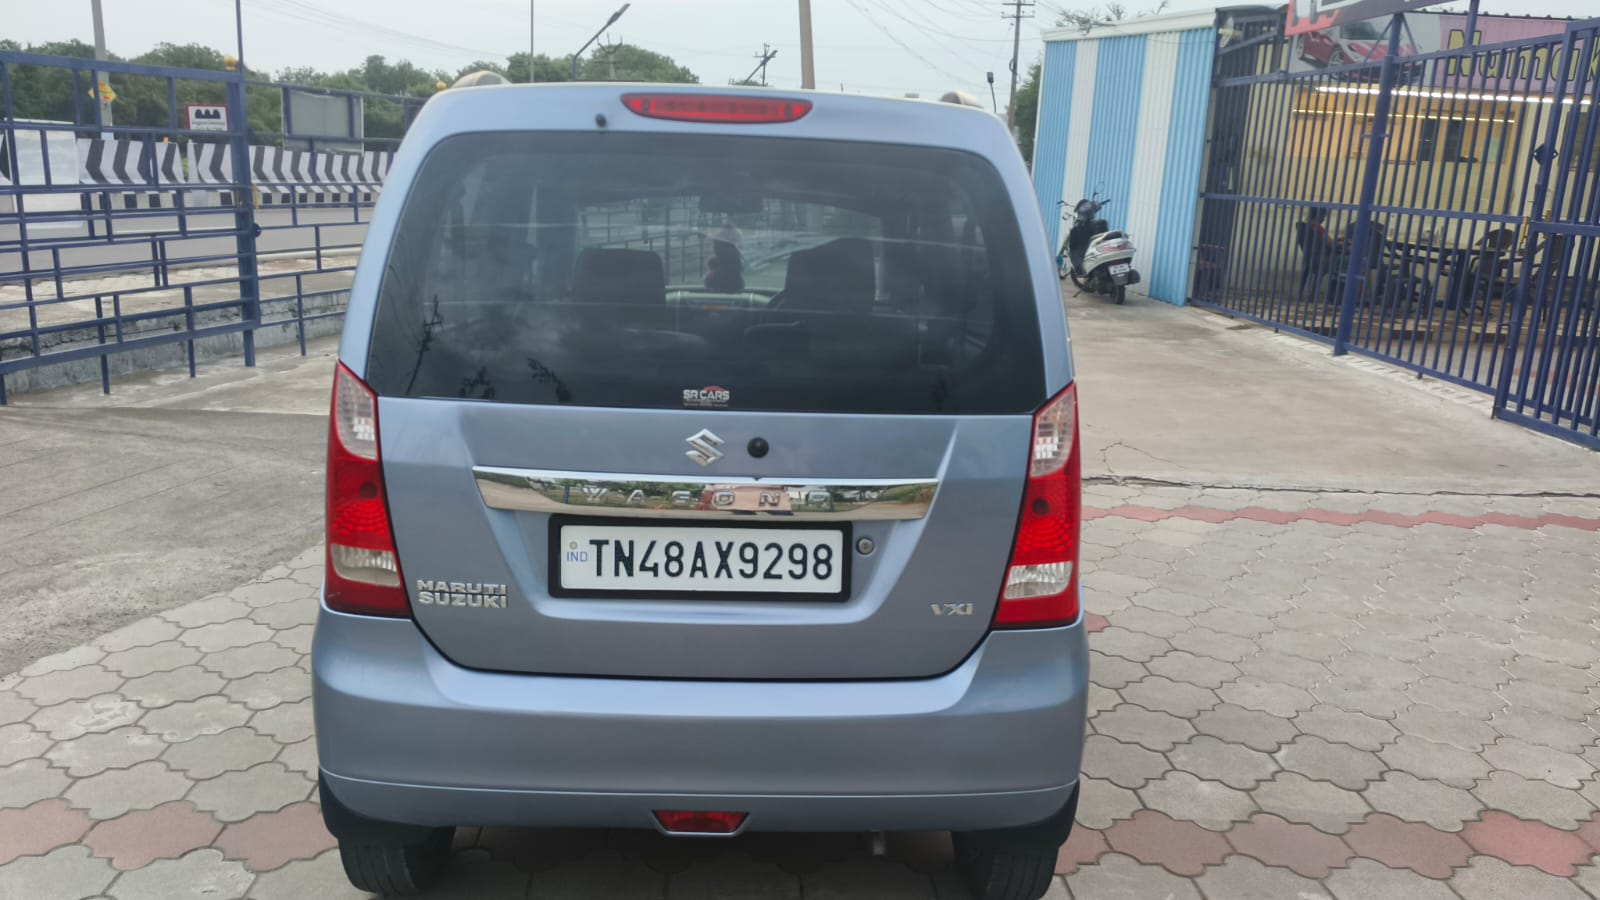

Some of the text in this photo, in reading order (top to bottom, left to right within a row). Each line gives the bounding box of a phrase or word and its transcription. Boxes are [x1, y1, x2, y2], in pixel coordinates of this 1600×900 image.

[683, 389, 730, 401] SR CARS
[566, 551, 588, 562] IND
[589, 539, 833, 580] TN48AX9298
[416, 579, 507, 595] MARUTI
[418, 591, 507, 609] SUZUKI
